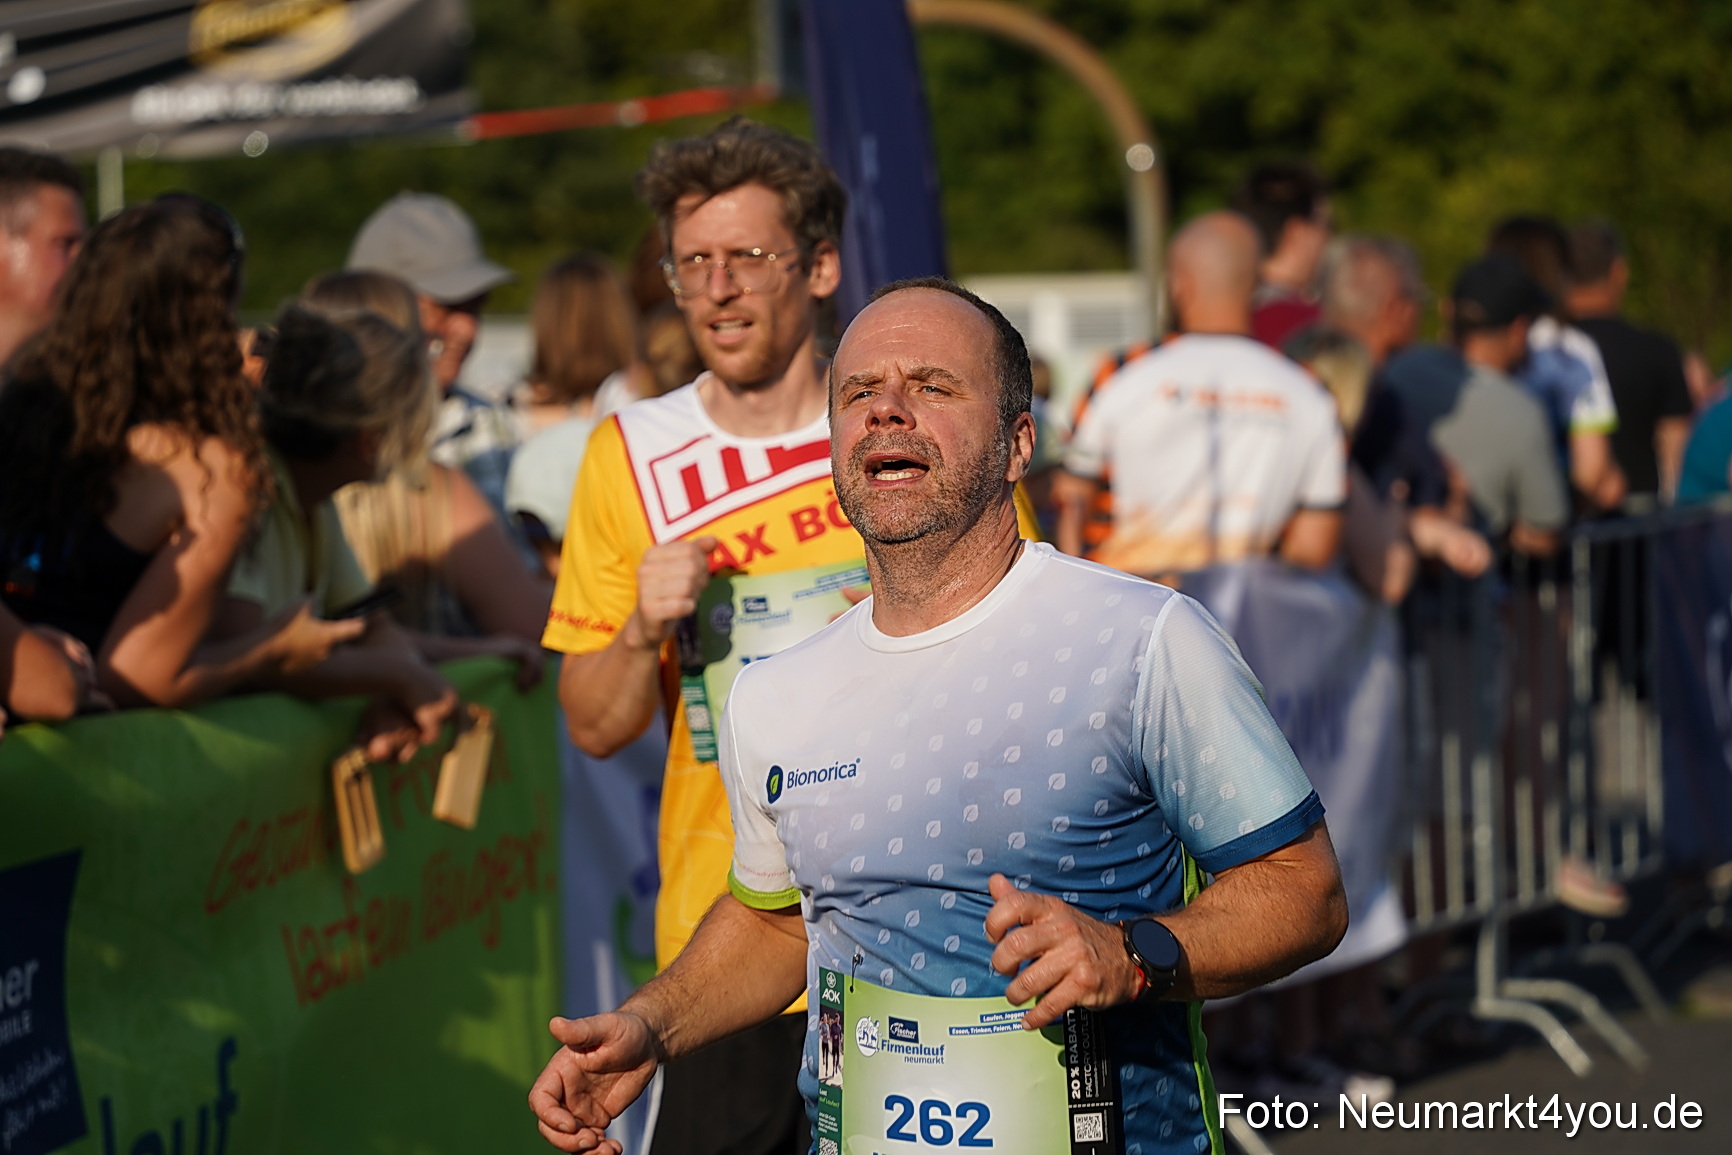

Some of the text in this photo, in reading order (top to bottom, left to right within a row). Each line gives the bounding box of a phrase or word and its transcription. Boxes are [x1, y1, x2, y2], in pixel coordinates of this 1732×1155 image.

[707, 524, 777, 573] AX
[822, 988, 840, 1005] AOK
[881, 1039, 945, 1056] Firmenlauf
[904, 1056, 945, 1065] neumarkt
[1083, 1051, 1093, 1098] FACTORY
[1071, 1079, 1081, 1100] 20
[884, 1094, 994, 1148] 262
